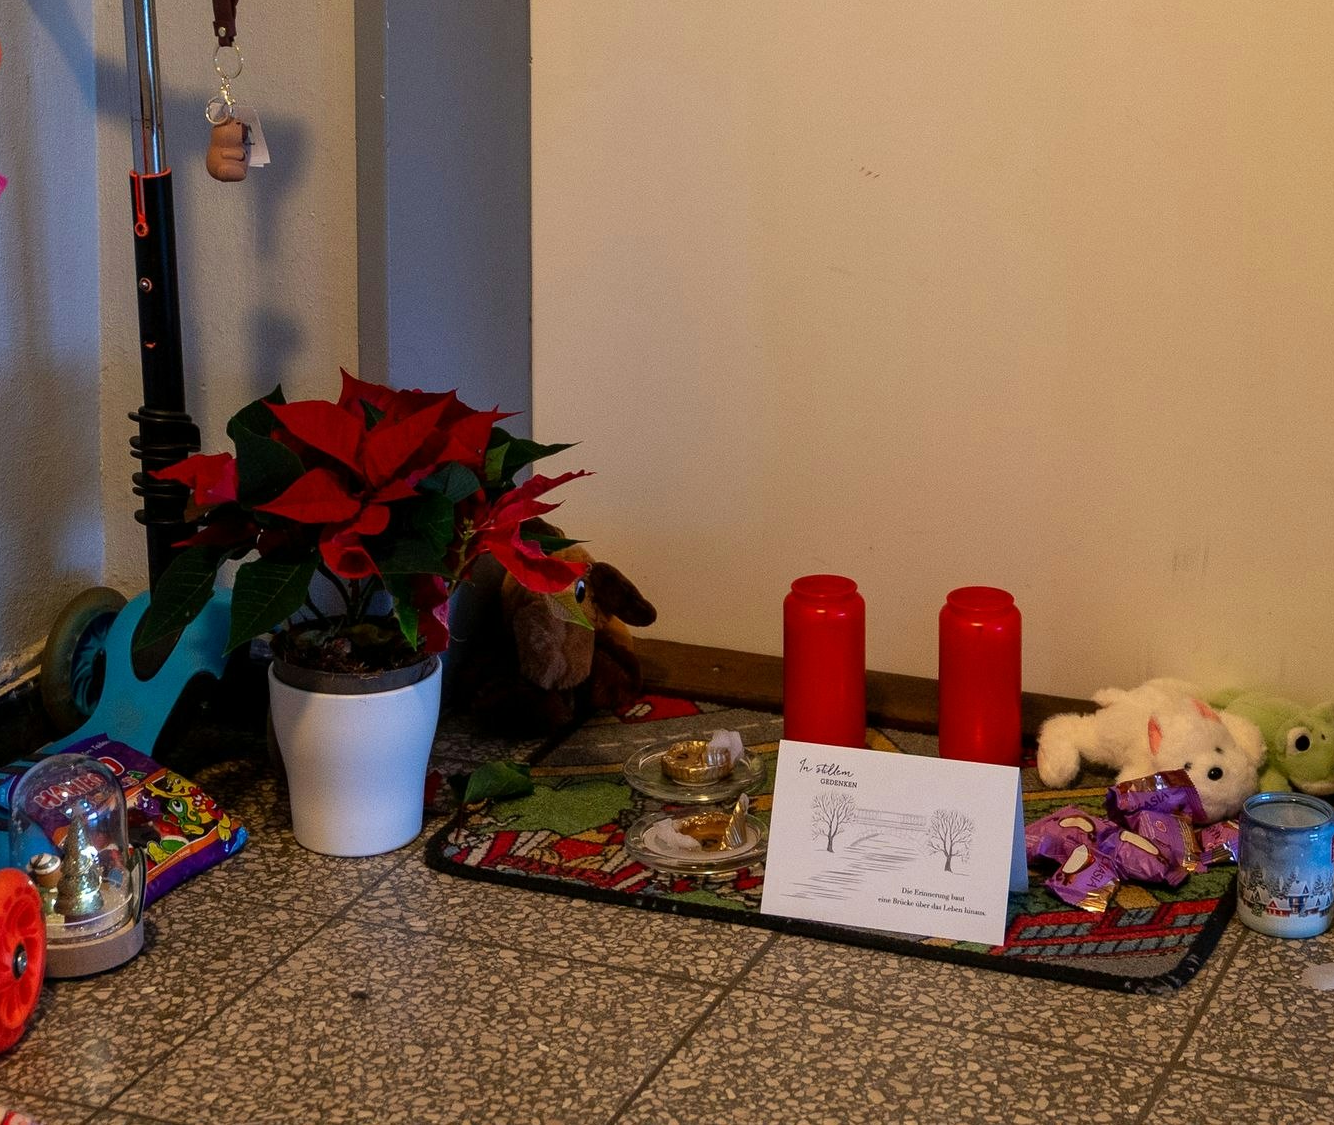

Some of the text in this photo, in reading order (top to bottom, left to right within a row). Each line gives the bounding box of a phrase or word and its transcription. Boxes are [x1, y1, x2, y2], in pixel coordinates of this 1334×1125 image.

[799, 757, 855, 777] In stillem
[820, 778, 858, 788] GEDENKEN
[901, 887, 913, 895] Die
[877, 896, 892, 904] eine
[943, 904, 963, 913] Leben
